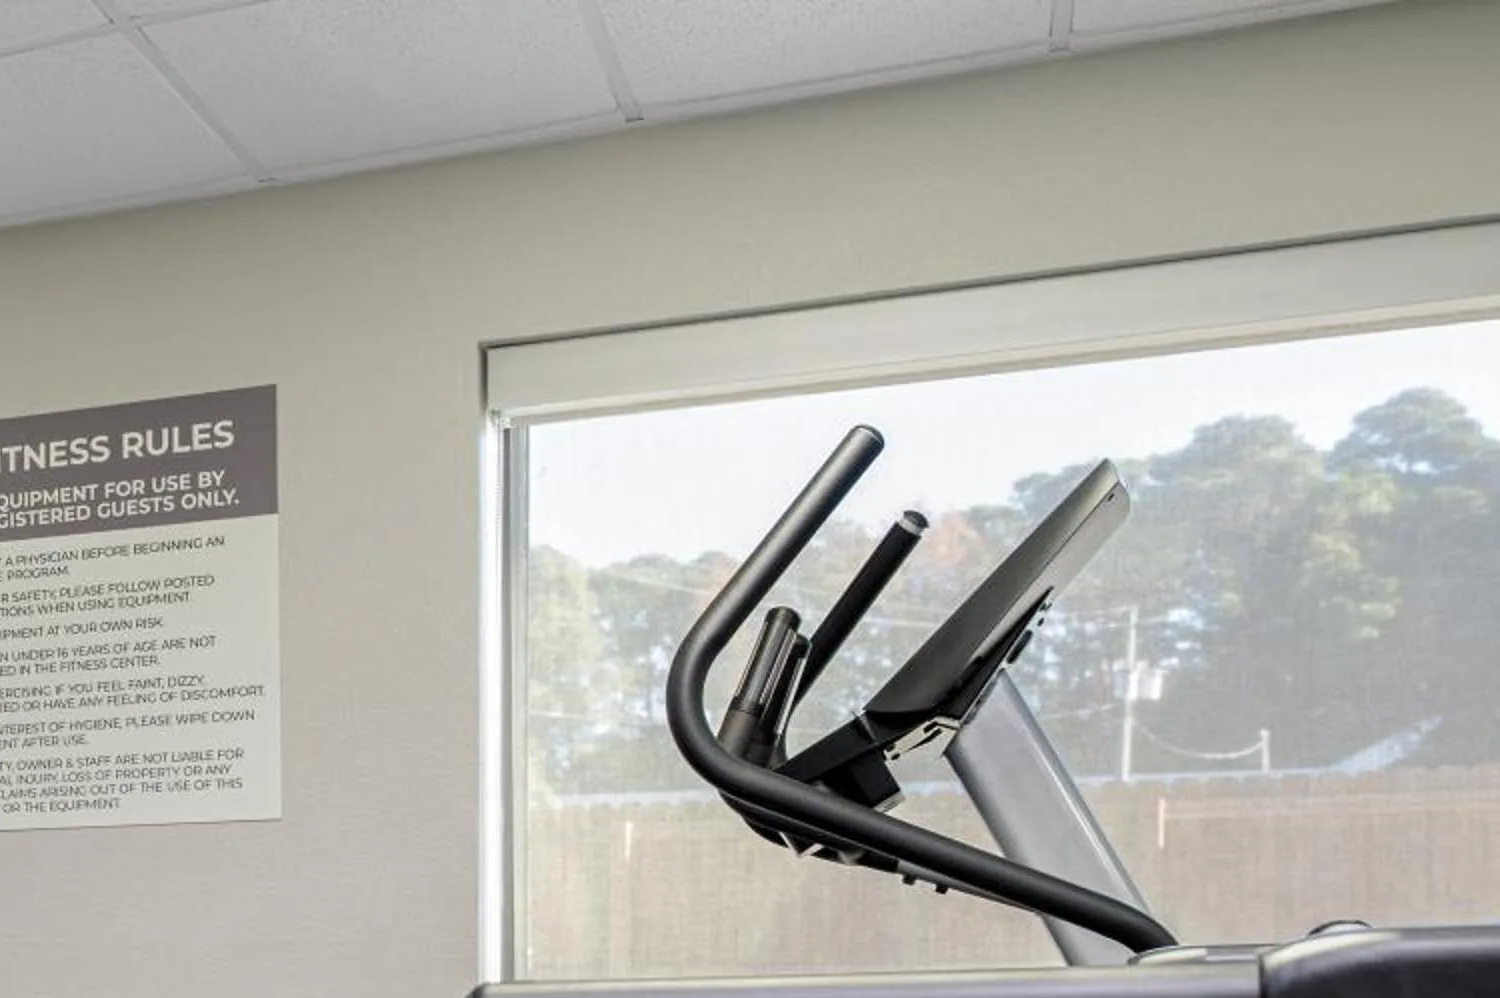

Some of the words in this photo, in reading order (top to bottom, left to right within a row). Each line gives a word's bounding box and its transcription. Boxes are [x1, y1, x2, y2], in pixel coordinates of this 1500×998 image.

[121, 419, 234, 460] RULES
[104, 479, 144, 499] FOR
[151, 474, 190, 494] USE
[198, 470, 224, 489] BY
[97, 495, 174, 518] GUESTS
[181, 489, 239, 510] ONLY.
[5, 556, 13, 567] A
[15, 550, 78, 566] PHYSICIAN
[81, 545, 129, 560] BEFORE
[133, 538, 201, 555] BEGINNING
[205, 536, 224, 548] AN
[59, 584, 104, 599] PLEASE
[108, 579, 160, 595] FOLLOW
[163, 575, 214, 590] POSTED
[37, 601, 74, 615] WHEN
[77, 598, 114, 612] USING
[47, 625, 61, 636] AT
[64, 622, 96, 635] YOUR
[100, 619, 133, 632] OWN
[11, 647, 54, 662] UNDER
[57, 646, 68, 658] 16
[71, 643, 109, 657] YEARS
[113, 642, 129, 654] OF
[133, 640, 158, 653] AGE
[161, 638, 185, 651] ARE
[189, 636, 216, 649] NOT
[19, 664, 30, 675] IN
[34, 662, 56, 674] THE
[59, 658, 107, 672] FITNESS
[55, 684, 64, 696] IF
[67, 682, 92, 695] YOU
[96, 680, 124, 693] FEEL
[22, 700, 40, 711] OR
[43, 697, 74, 710] HAVE
[77, 696, 103, 708] ANY
[107, 692, 156, 706] FEELING
[159, 691, 177, 703] OF
[48, 721, 65, 732] OF
[125, 715, 171, 728] PLEASE
[175, 712, 208, 725] WIPE
[211, 710, 254, 723] DOWN
[22, 735, 58, 748] AFTER
[16, 757, 63, 771] OWNER
[66, 757, 73, 768] &
[76, 755, 112, 768] STAFF
[115, 754, 138, 766] ARE
[142, 752, 168, 765] NOT
[171, 750, 214, 763] LIABLE
[217, 748, 244, 761] FOR
[62, 770, 93, 783] LOSS
[95, 769, 112, 781] OF
[115, 766, 180, 781] PROPERTY
[183, 765, 203, 778] OR
[205, 764, 231, 777] ANY
[38, 785, 86, 798] ARISING
[89, 783, 116, 796] OUT
[118, 783, 135, 795] OF
[139, 781, 163, 794] THE
[165, 780, 190, 793] USE
[193, 779, 210, 791] OF
[215, 778, 242, 791] THIS
[1, 802, 20, 814] OR
[23, 801, 47, 813] THE
